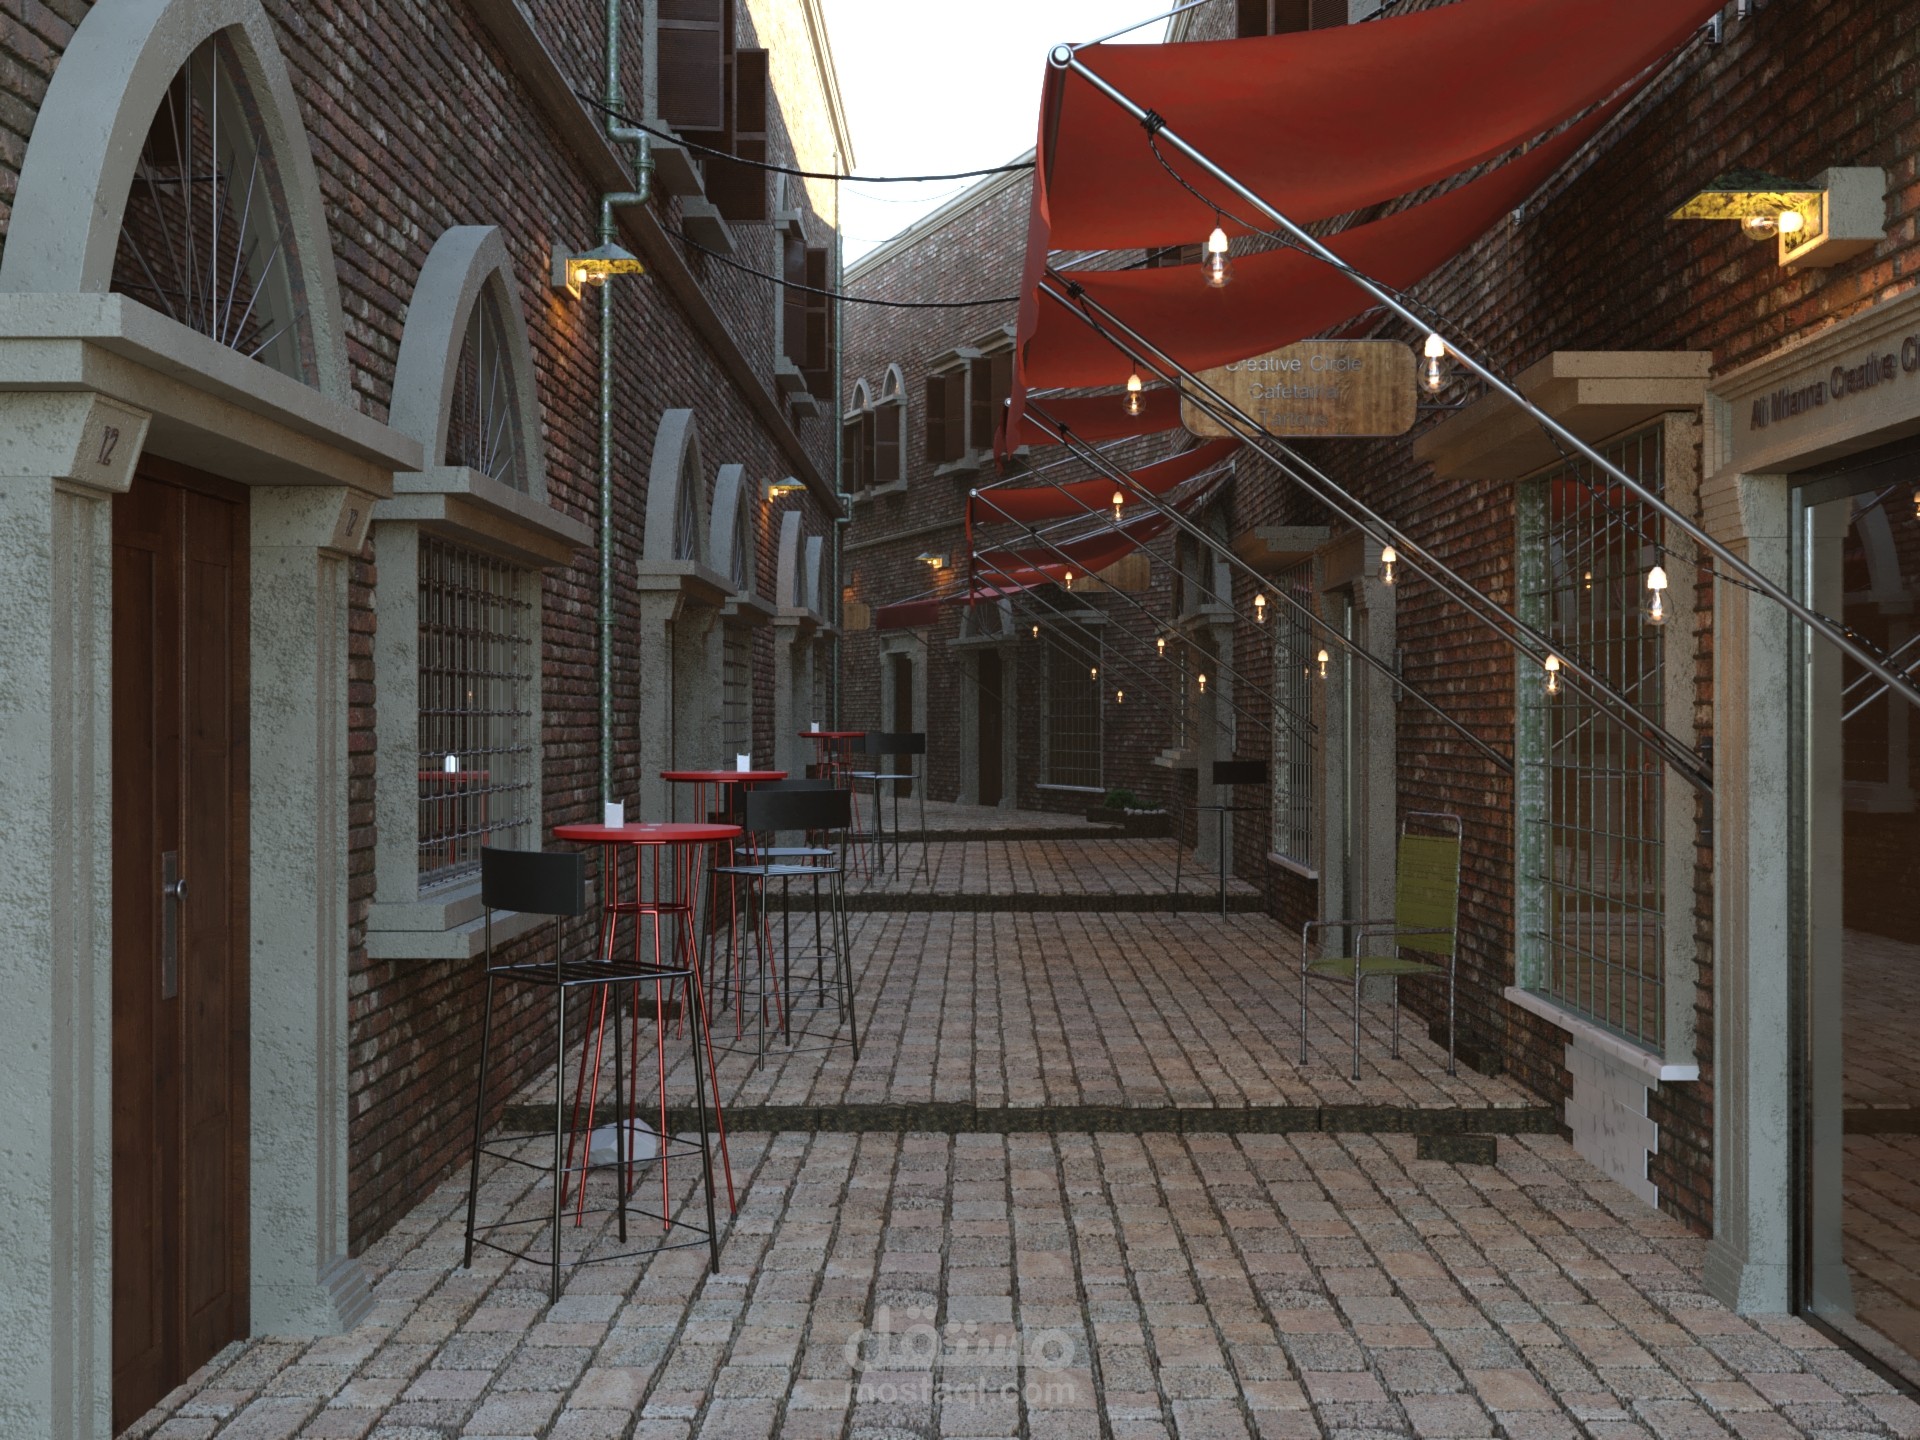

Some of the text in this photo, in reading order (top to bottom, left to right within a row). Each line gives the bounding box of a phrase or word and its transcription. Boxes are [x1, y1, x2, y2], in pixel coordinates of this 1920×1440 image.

[1310, 355, 1362, 372] Circle
[1830, 352, 1898, 399] Creative
[96, 425, 120, 466] 12
